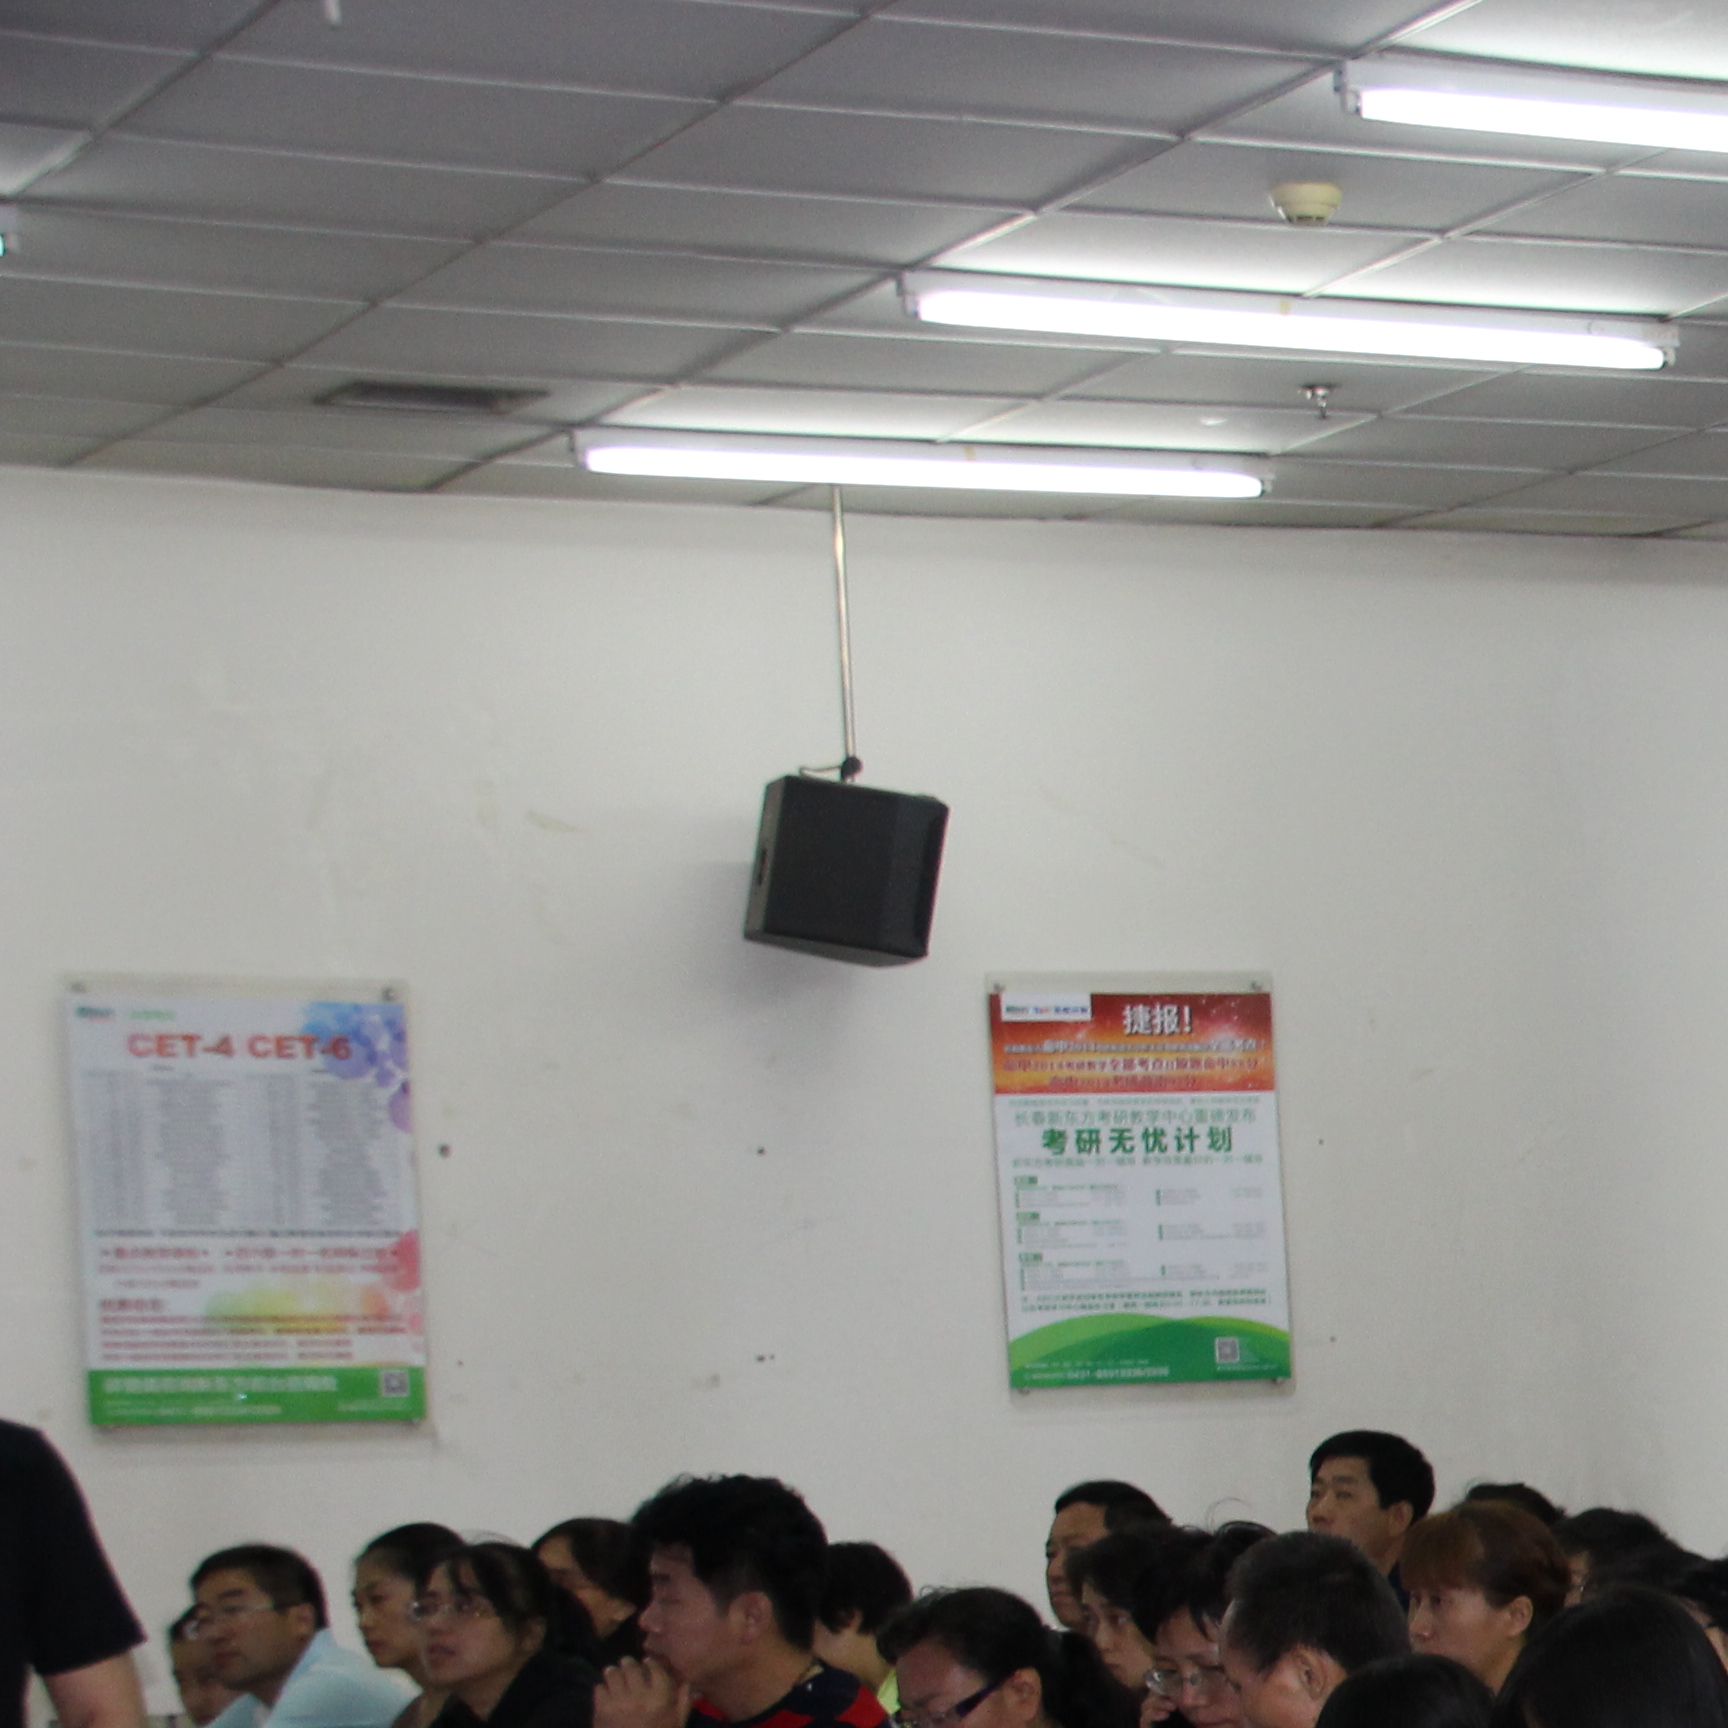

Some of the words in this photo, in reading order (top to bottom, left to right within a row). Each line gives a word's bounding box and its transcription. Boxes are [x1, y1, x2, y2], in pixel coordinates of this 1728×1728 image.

[127, 1034, 235, 1060] CET-4
[248, 1034, 352, 1061] CET-6
[1041, 1125, 1233, 1156] 考研无忧计划
